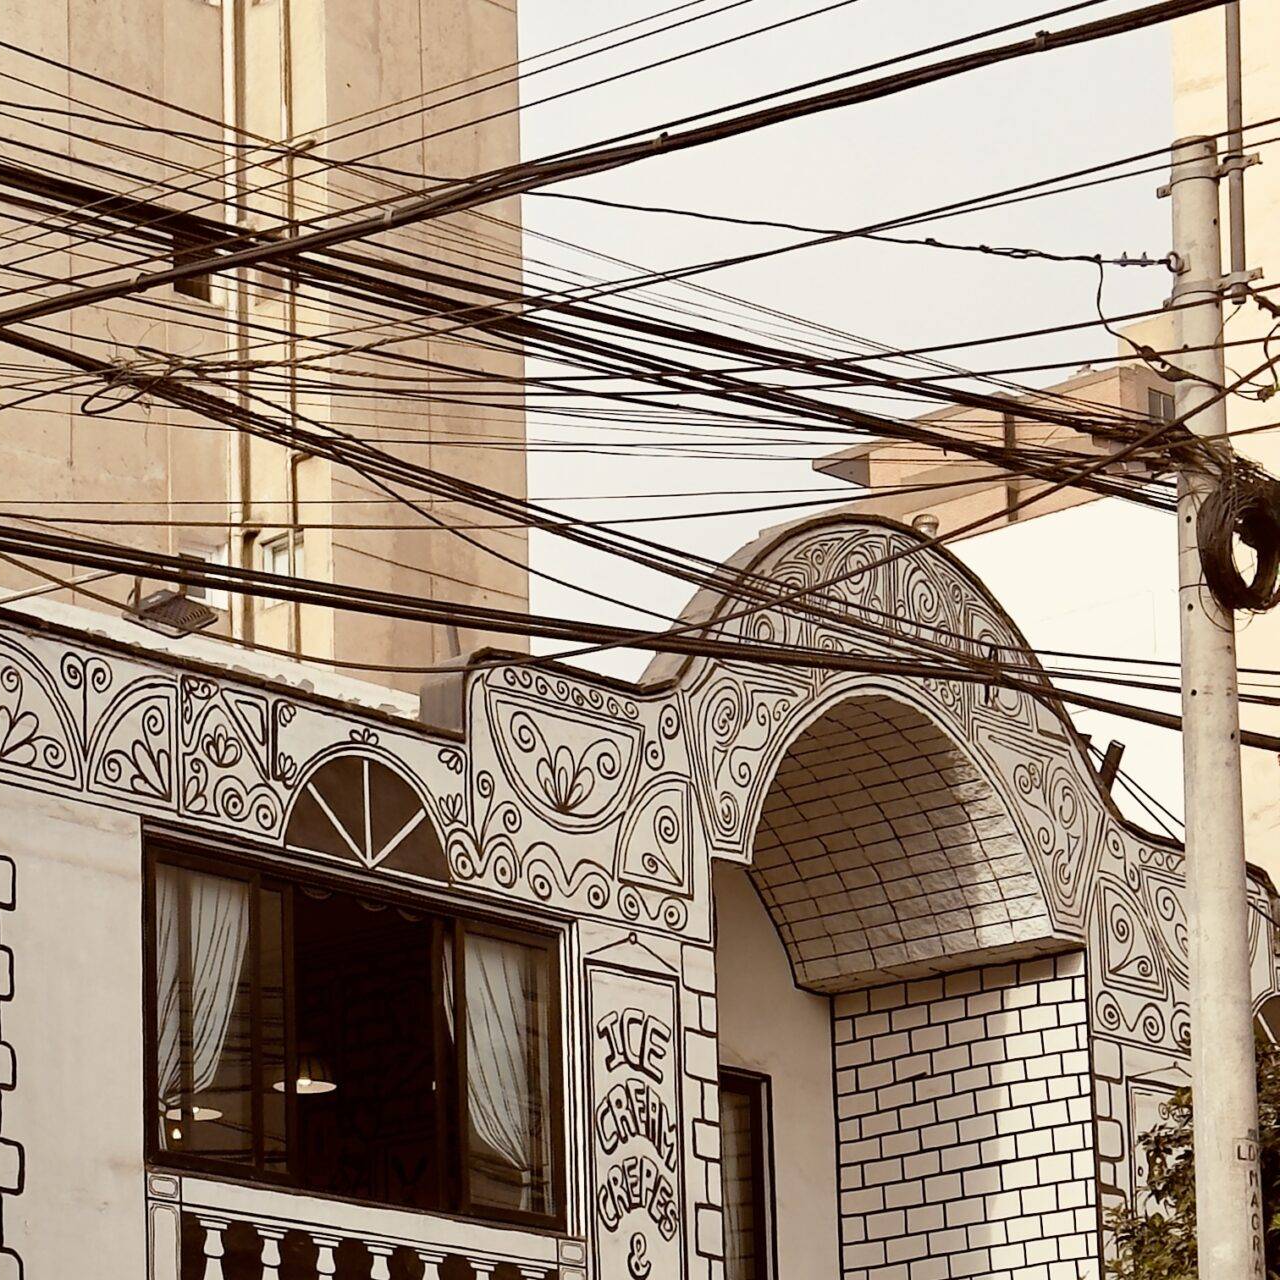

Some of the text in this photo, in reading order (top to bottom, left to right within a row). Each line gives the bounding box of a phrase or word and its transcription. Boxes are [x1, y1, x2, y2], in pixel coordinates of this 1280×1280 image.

[597, 1007, 671, 1085] ICE
[595, 1077, 677, 1173] CREAM
[597, 1155, 679, 1242] CREPES
